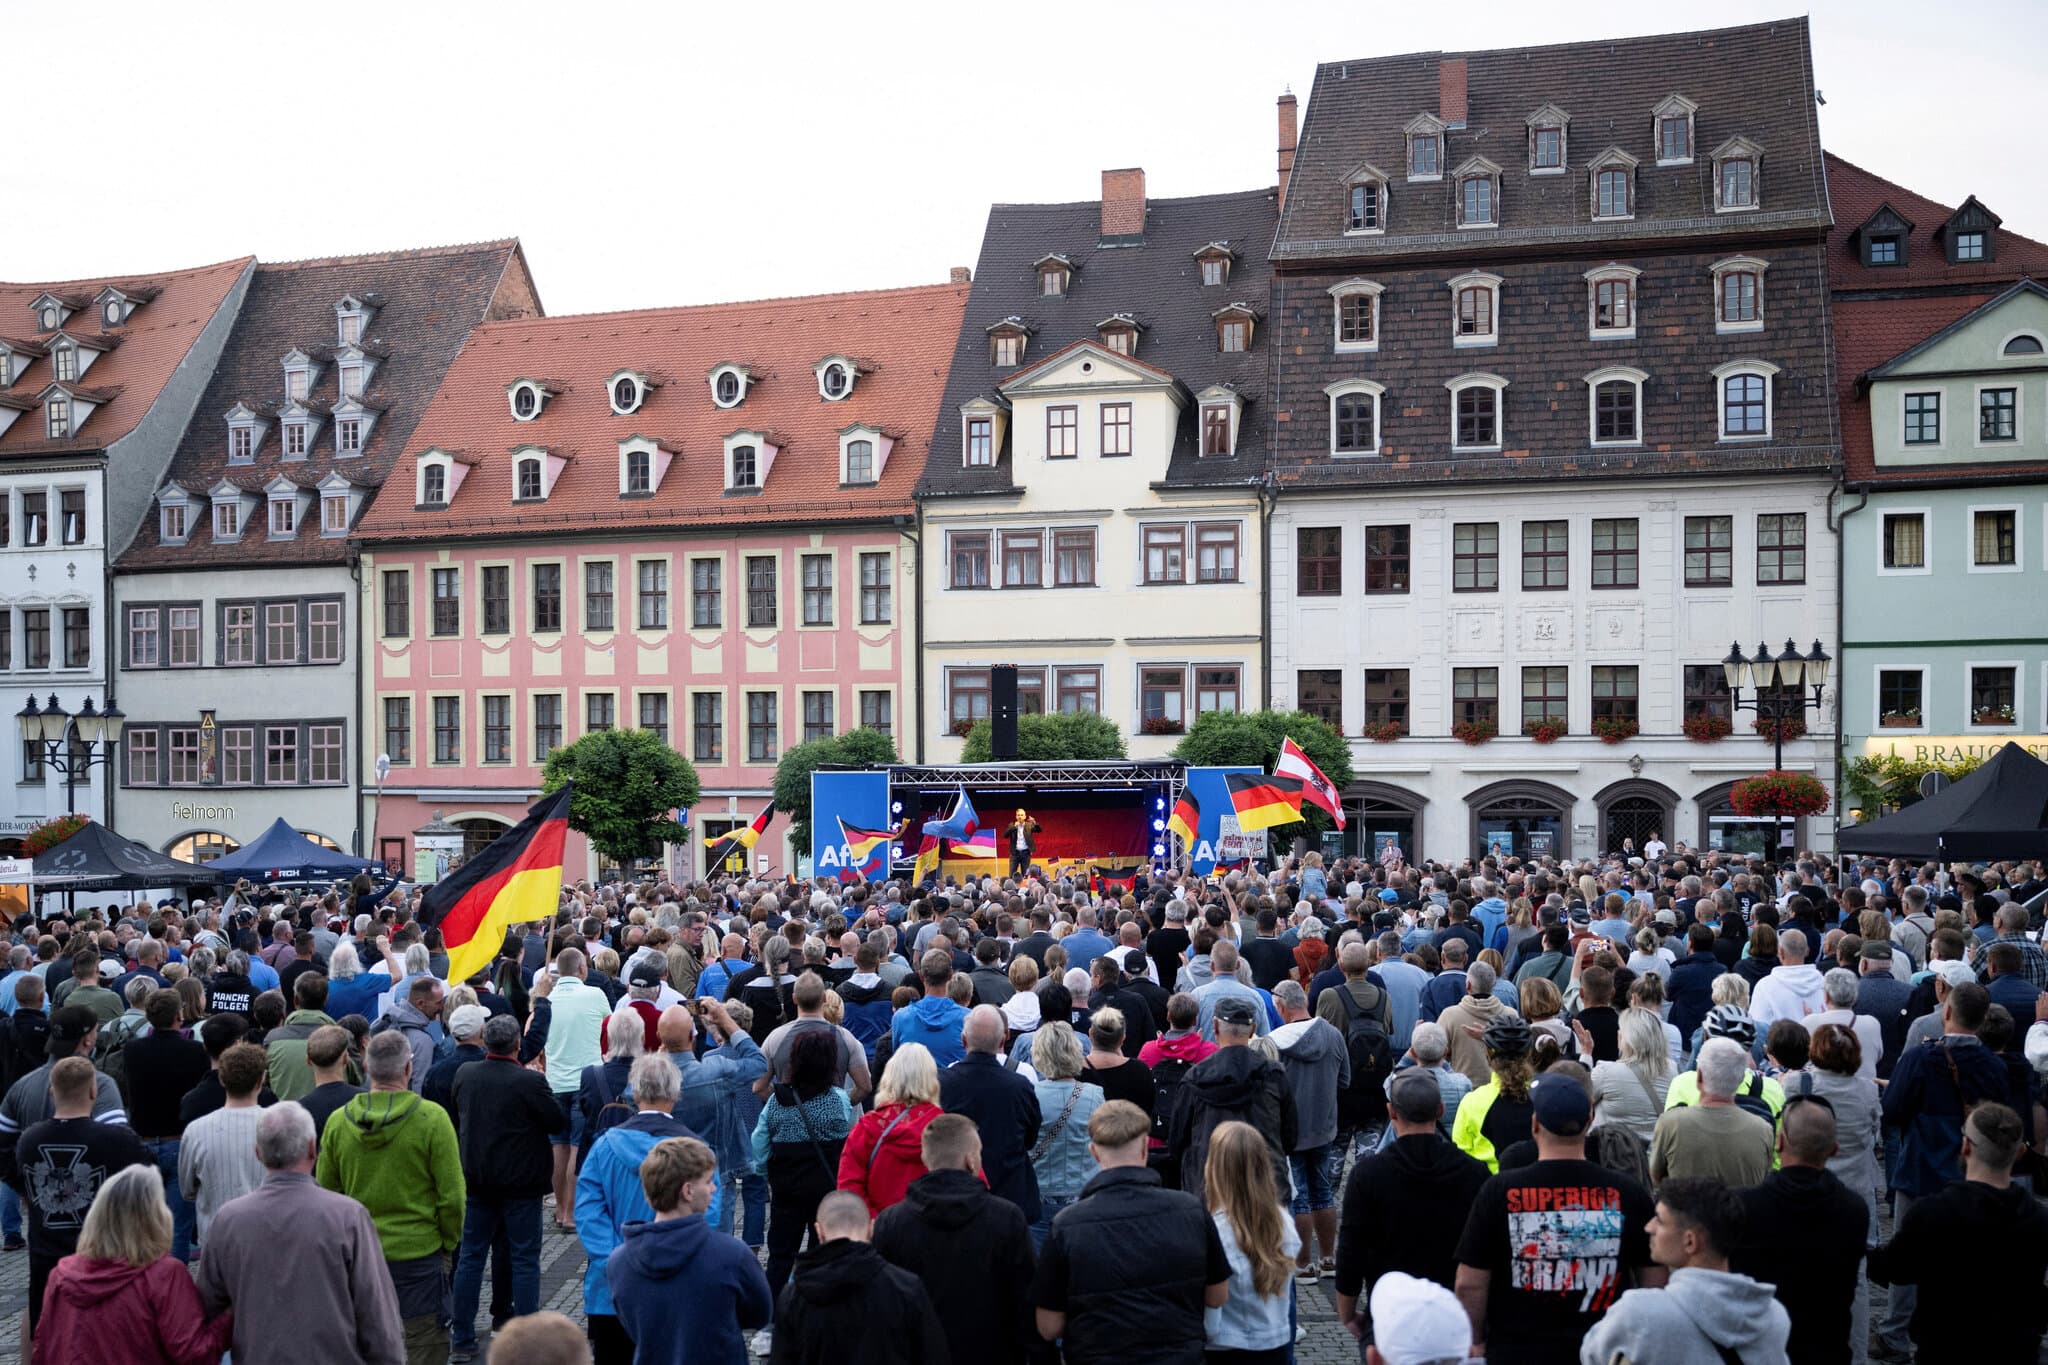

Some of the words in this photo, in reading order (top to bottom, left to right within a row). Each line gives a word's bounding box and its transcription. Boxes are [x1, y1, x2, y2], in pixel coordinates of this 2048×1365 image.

[172, 801, 234, 820] fielmann
[213, 992, 250, 1002] MANCHE
[212, 1001, 249, 1011] FOLGEN
[1506, 1187, 1621, 1212] SUPERIOR
